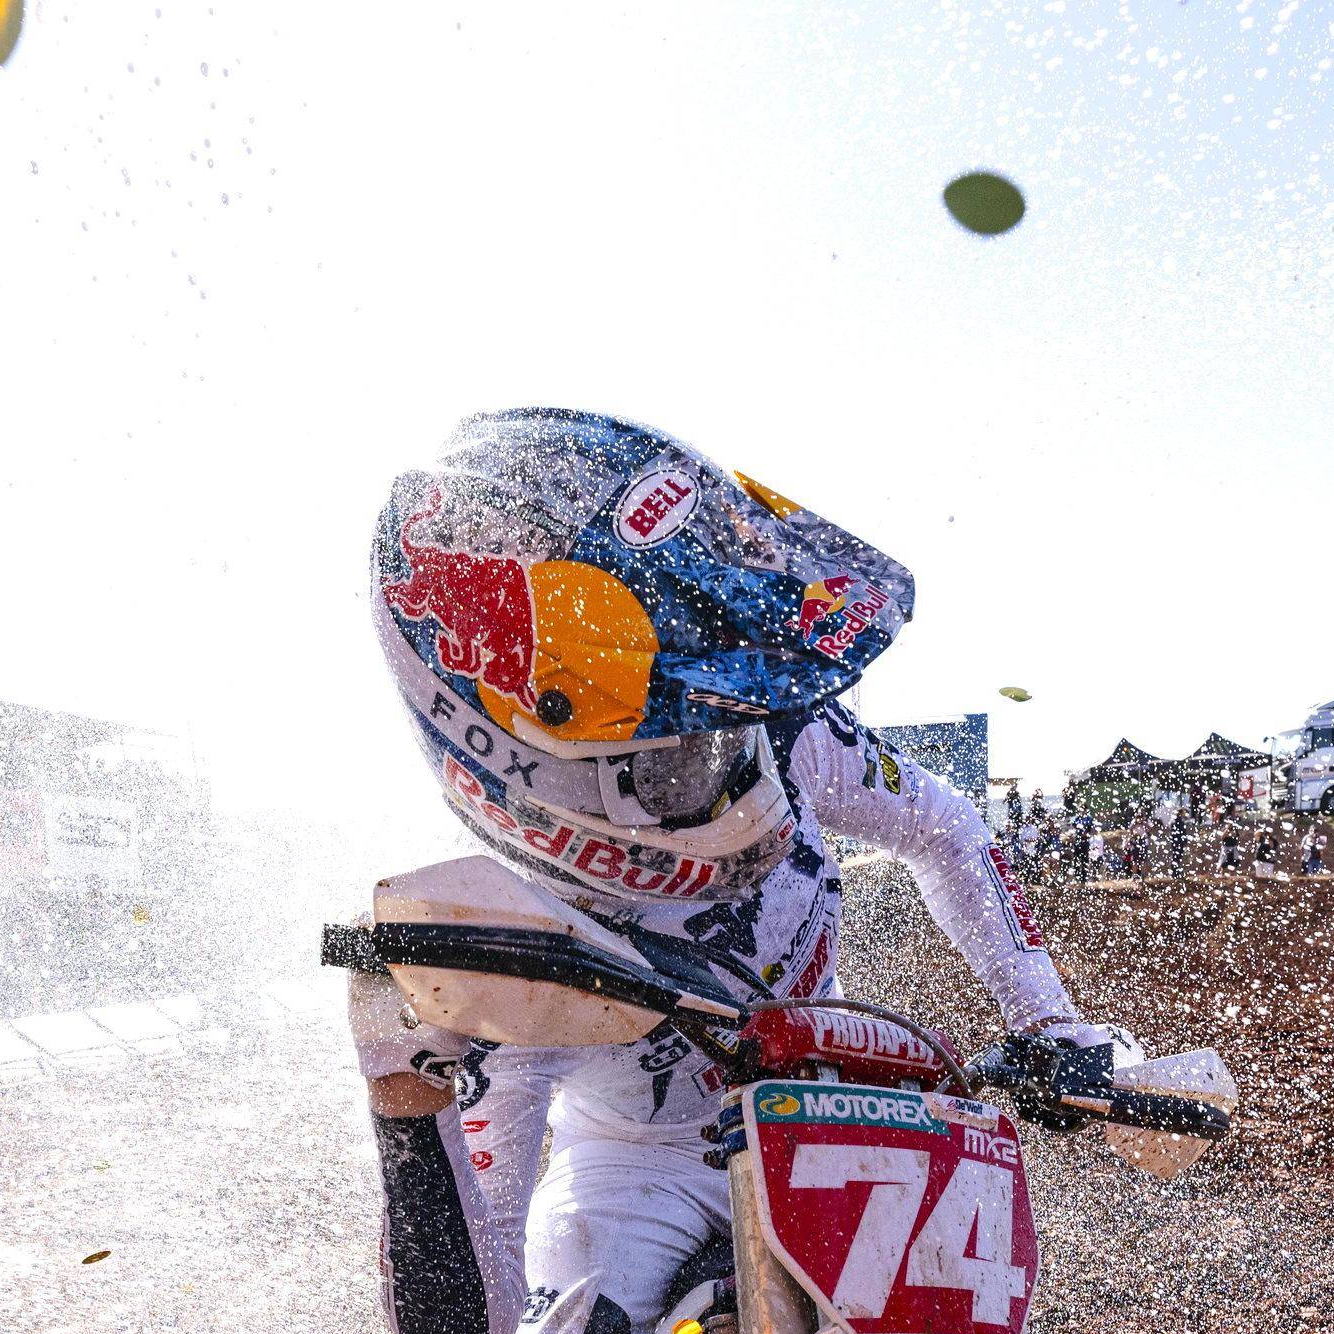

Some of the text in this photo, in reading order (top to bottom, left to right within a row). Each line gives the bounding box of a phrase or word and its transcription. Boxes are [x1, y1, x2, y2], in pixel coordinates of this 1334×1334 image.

[625, 478, 692, 538] BELL
[814, 583, 890, 660] Red Bull
[430, 691, 541, 789] FOX
[444, 752, 717, 898] Red Bull
[803, 1092, 932, 1127] MOTOREX
[956, 1099, 983, 1114] De Wolf
[964, 1126, 1018, 1164] MX2
[789, 1143, 1027, 1328] 74
